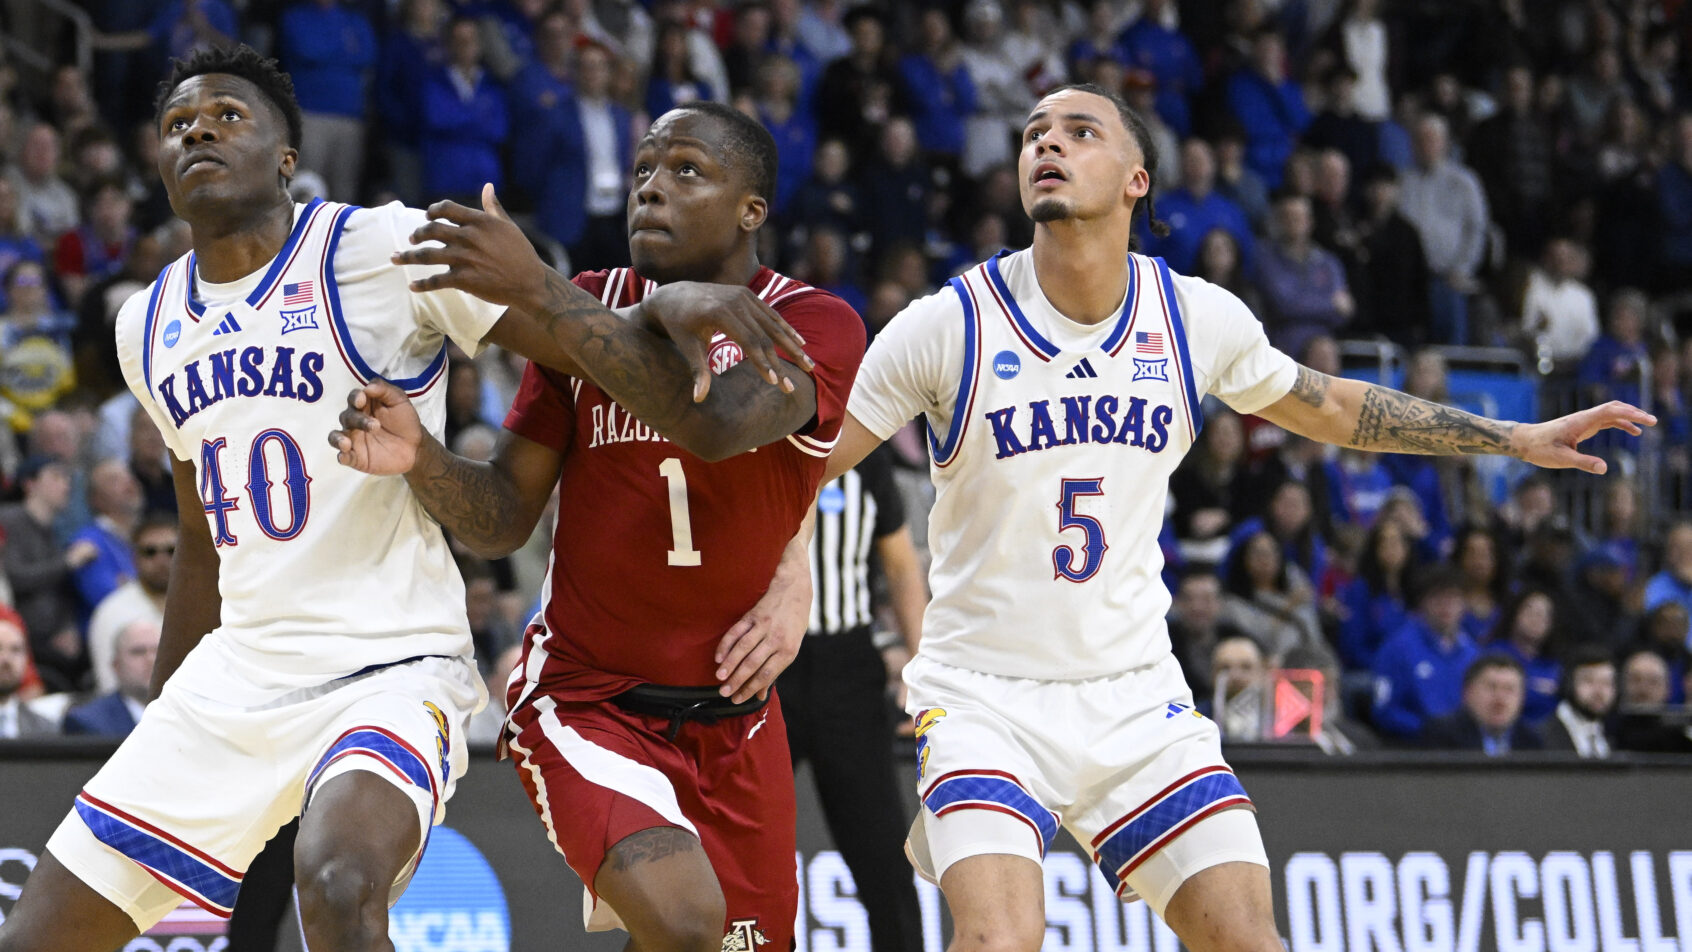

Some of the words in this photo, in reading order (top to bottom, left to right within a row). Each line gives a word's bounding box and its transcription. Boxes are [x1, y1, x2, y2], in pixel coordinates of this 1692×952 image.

[158, 346, 324, 430] KANSAS
[996, 363, 1019, 372] NCAA
[588, 401, 670, 448] RAZO
[985, 395, 1172, 459] KANSAS
[200, 428, 313, 548] 40
[659, 458, 702, 566] 1
[1052, 477, 1109, 583] 5
